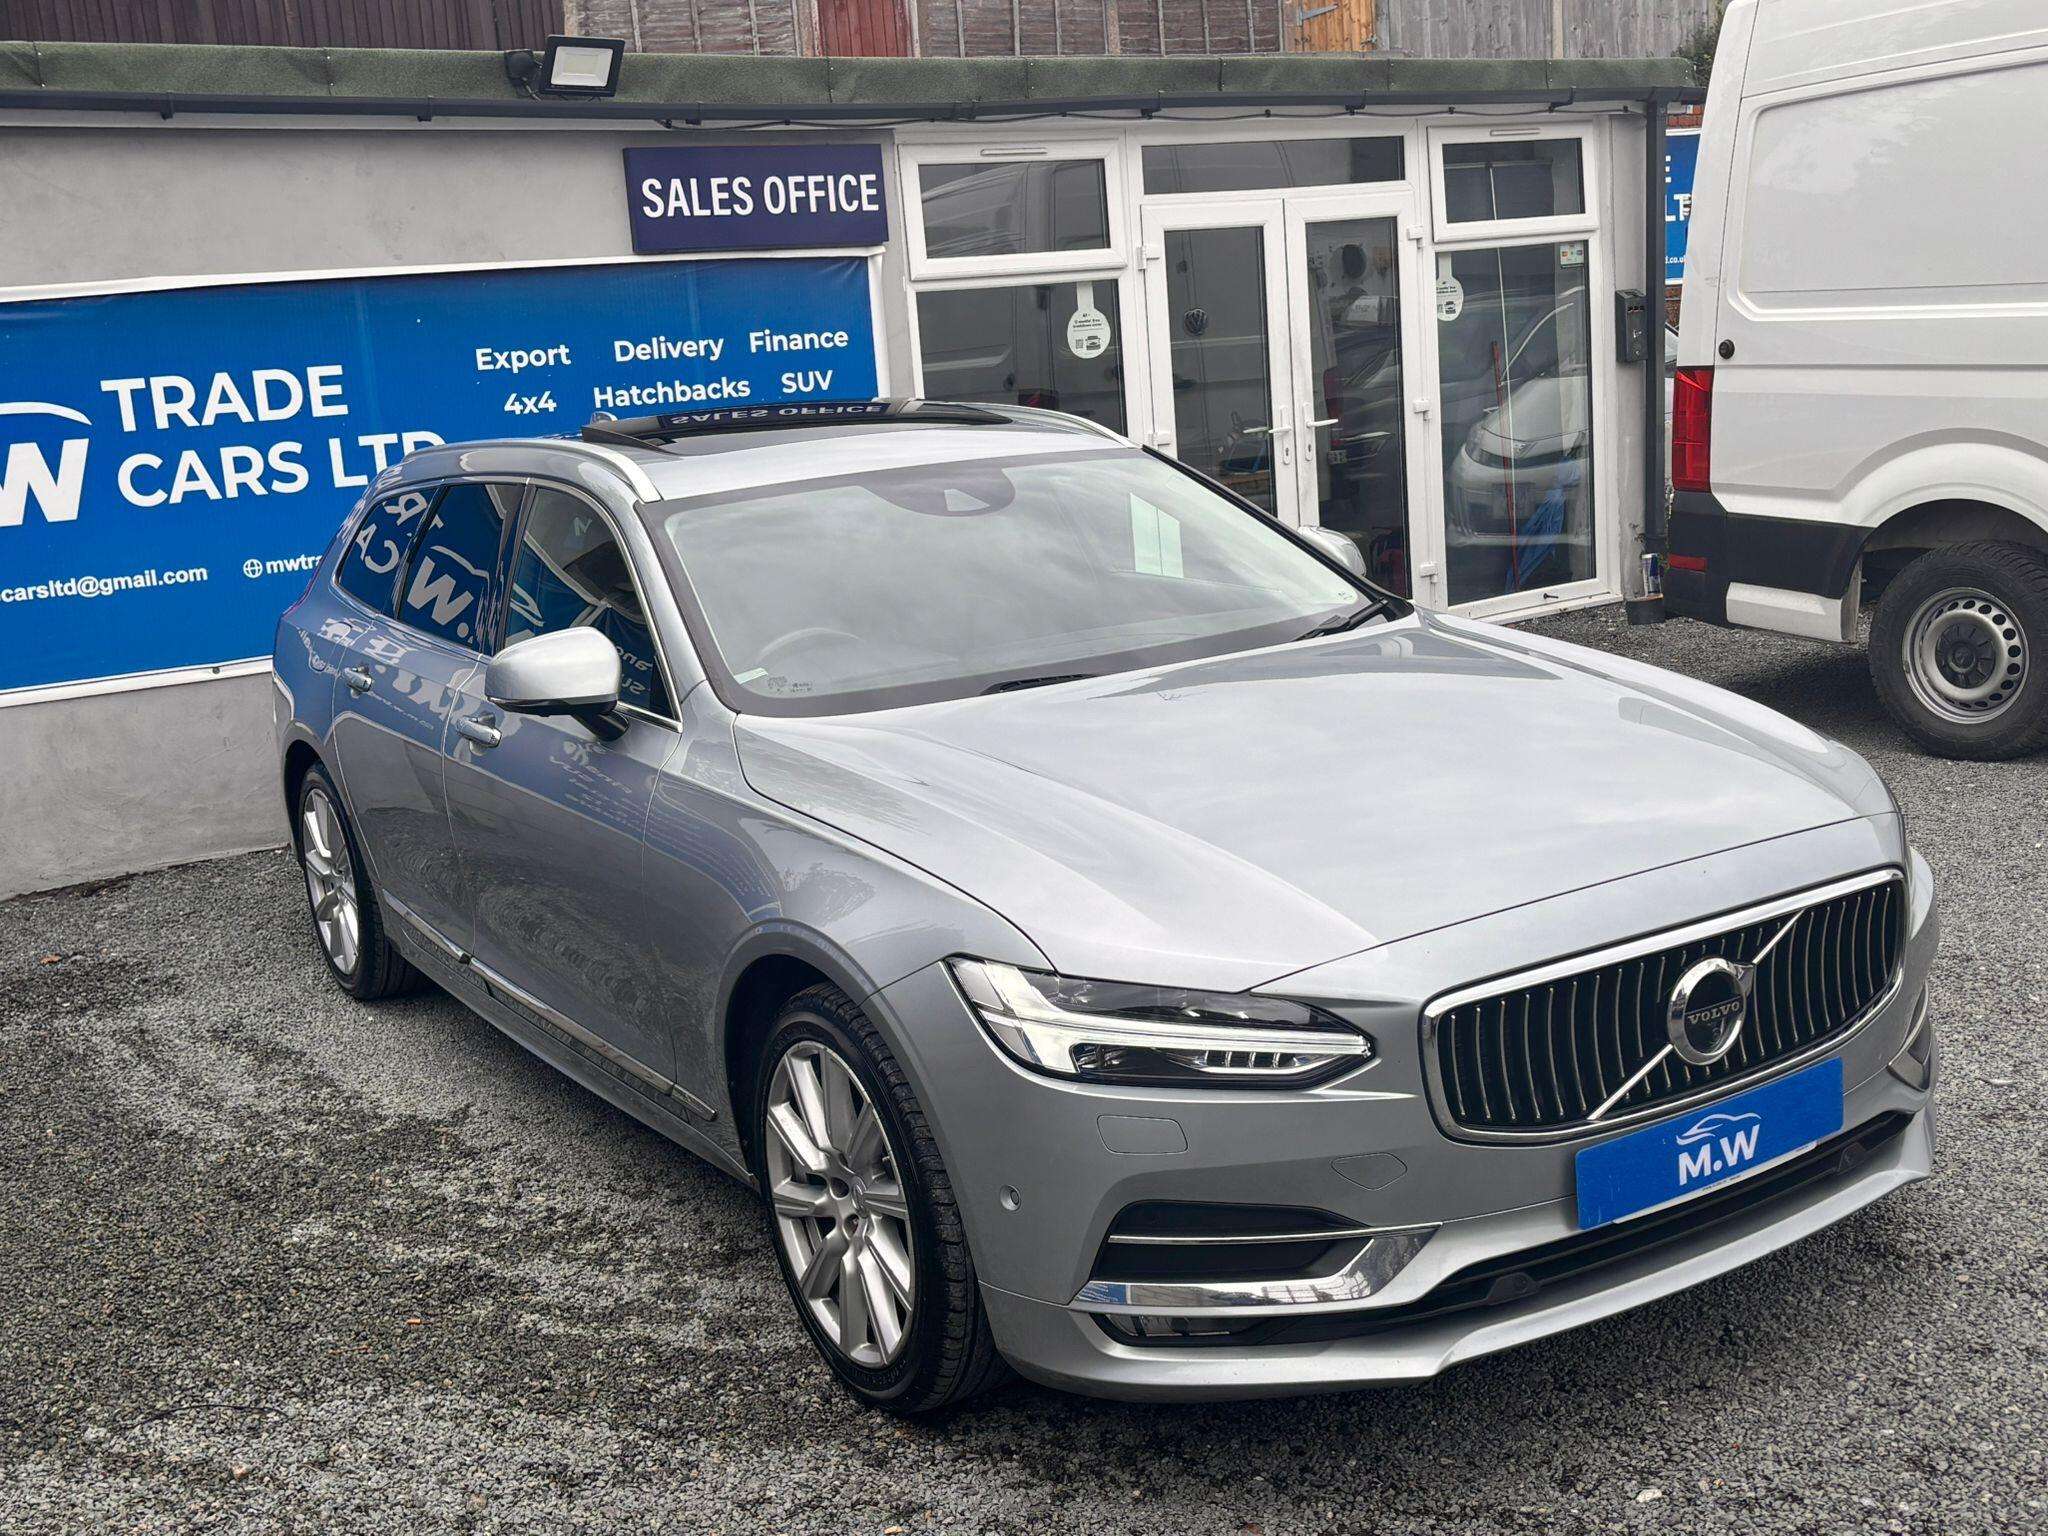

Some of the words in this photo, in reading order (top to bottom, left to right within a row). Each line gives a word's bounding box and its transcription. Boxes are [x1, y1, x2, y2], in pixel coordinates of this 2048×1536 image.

[642, 176, 754, 219] SALES
[763, 174, 879, 215] OFFICE
[1665, 193, 1691, 222] LT
[476, 344, 571, 374] Export
[614, 335, 724, 364] Delivery
[749, 329, 849, 354] Finance
[101, 365, 348, 432] TRADE
[503, 391, 557, 415] 4x4
[594, 377, 751, 409] Hatchbacks
[781, 370, 833, 395] SUV
[118, 442, 309, 507] CARS
[0, 566, 208, 603] carsltd@gmail.com
[1688, 1000, 1741, 1025] VOLVO
[1678, 1124, 1760, 1186] M.W
